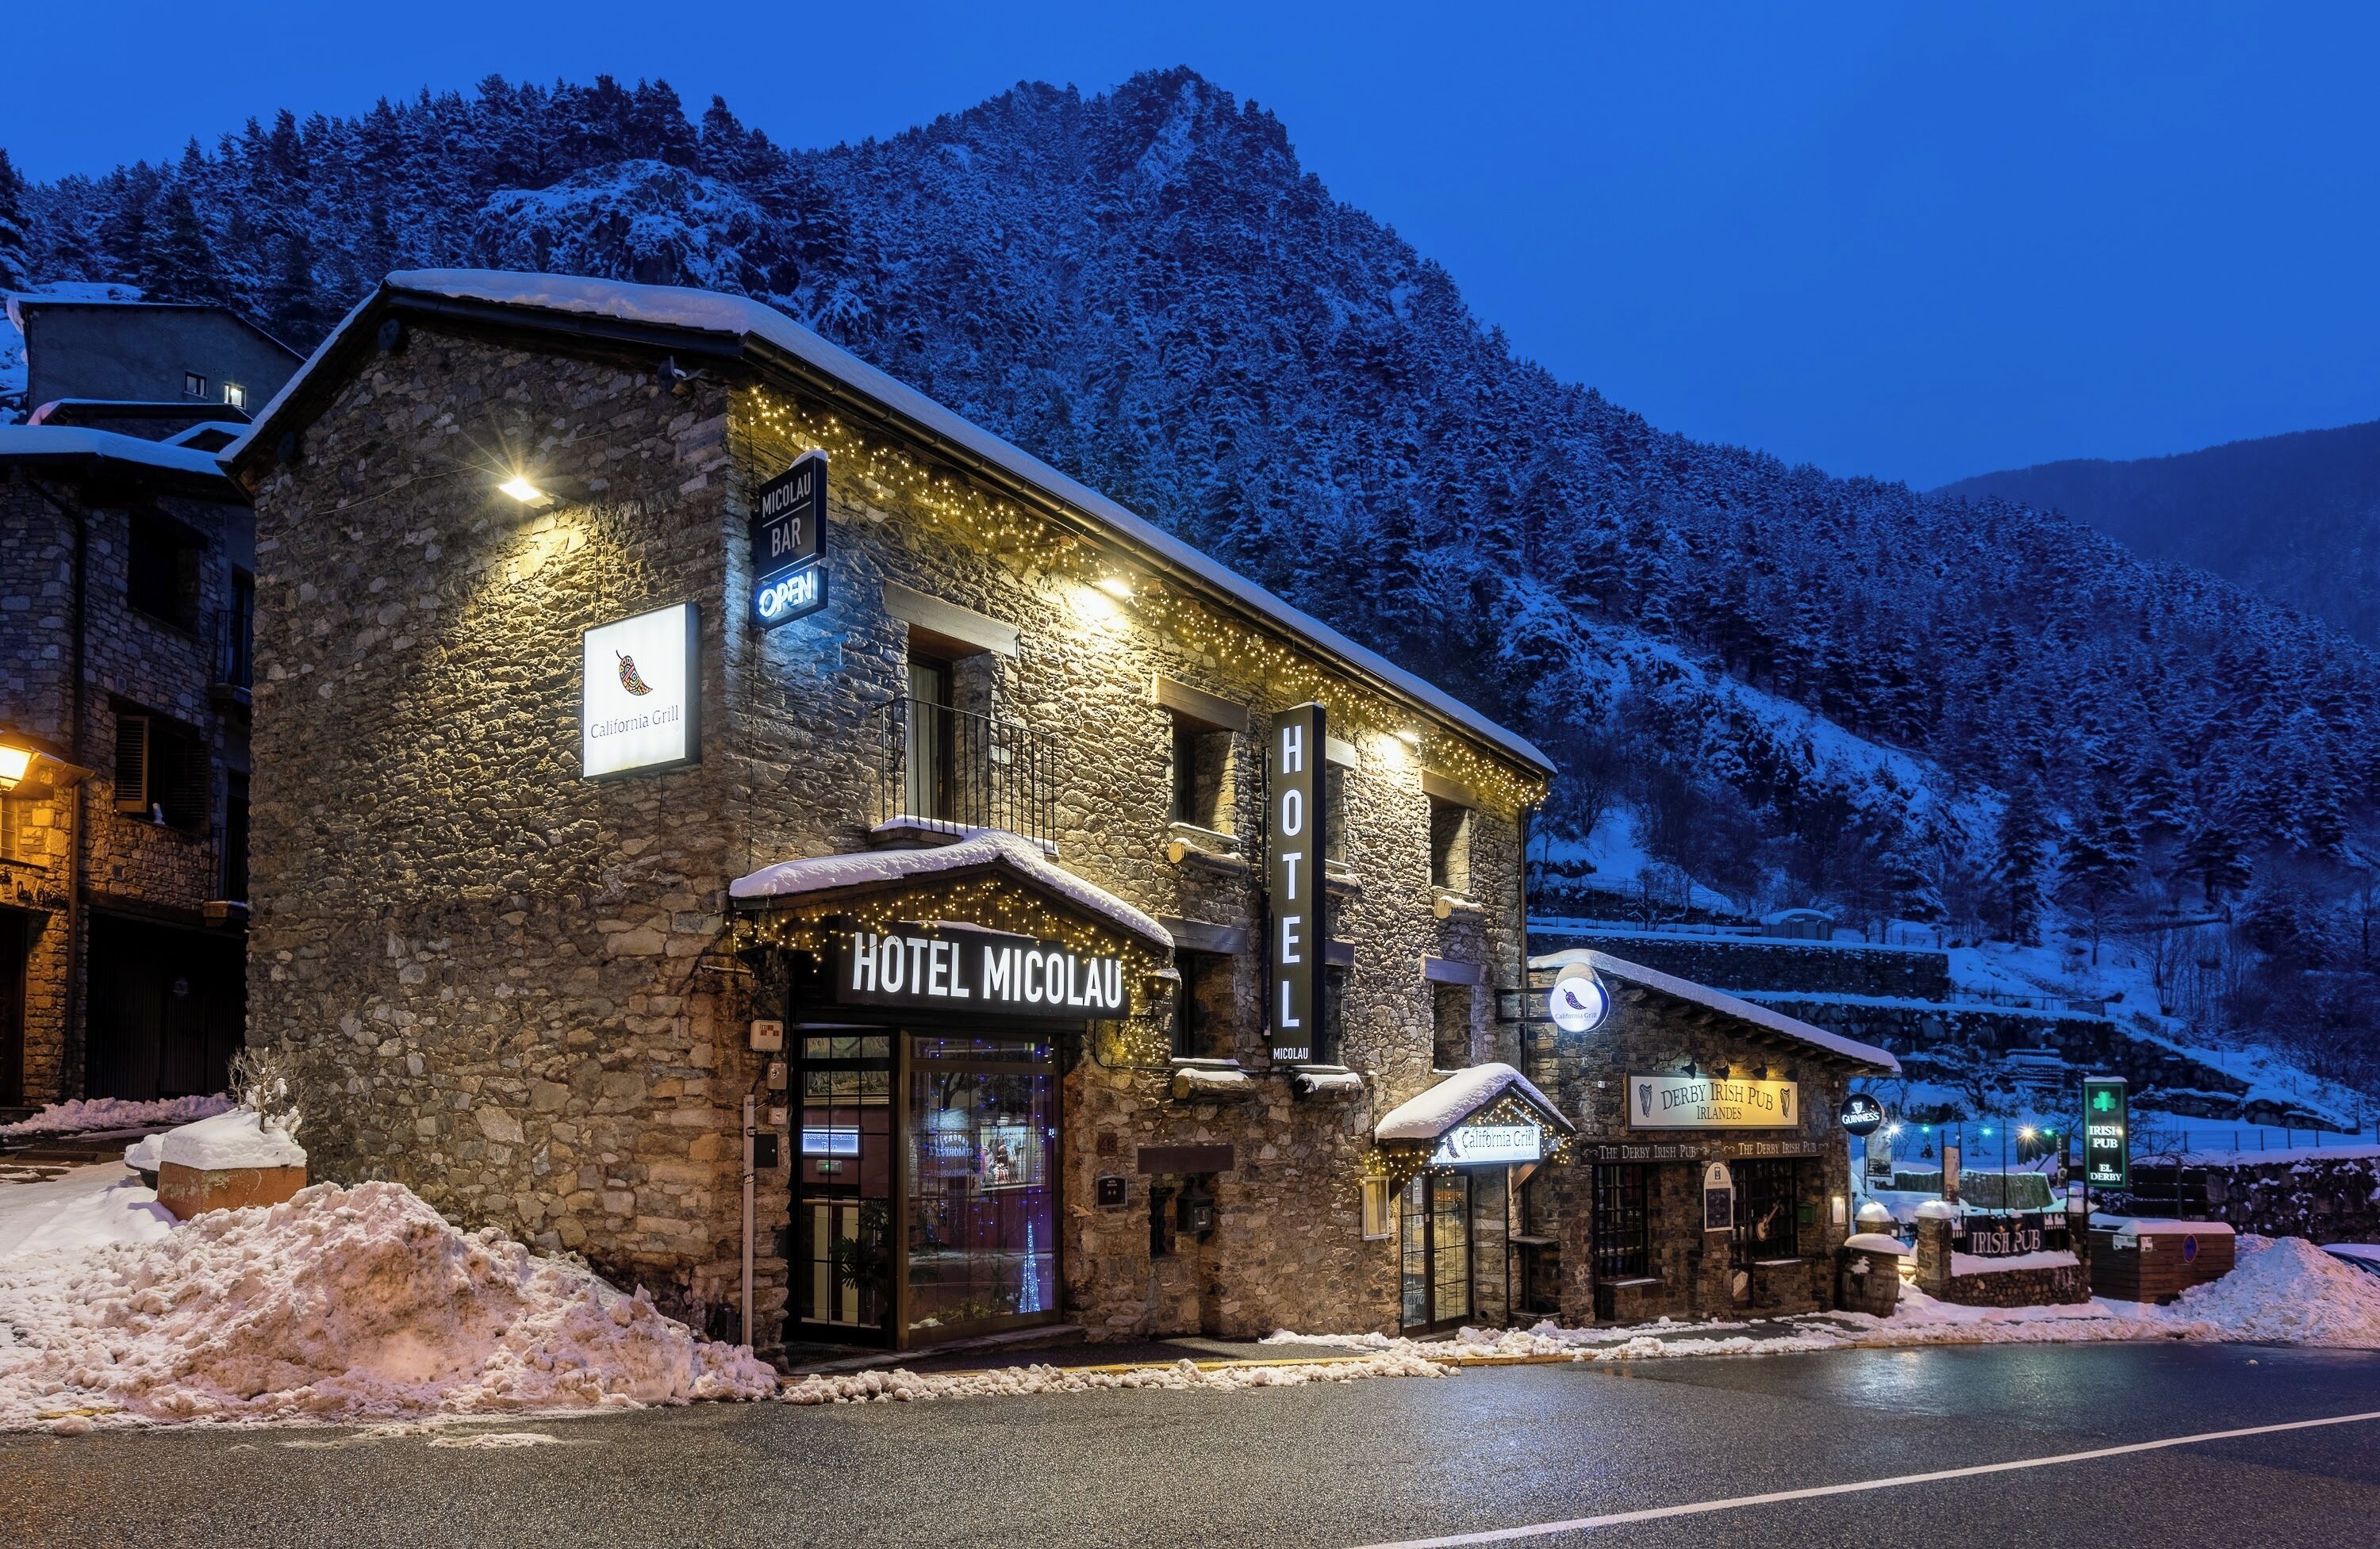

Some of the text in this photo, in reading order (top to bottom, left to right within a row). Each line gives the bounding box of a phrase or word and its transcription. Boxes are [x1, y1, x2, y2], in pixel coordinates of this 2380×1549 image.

[762, 472, 811, 518] MICOLAU
[772, 517, 801, 558] BAR
[759, 570, 812, 617] OPEN
[591, 705, 678, 738] California Grill
[1281, 725, 1303, 1028] HOTEL
[852, 932, 1123, 1008] HOTEL MICOLAU
[1273, 1047, 1308, 1060] MICOLAU
[1660, 1082, 1773, 1111] DERBY IRISH PUB
[1696, 1106, 1742, 1120] IRLANDES
[1841, 1112, 1879, 1125] GUINNESS
[1100, 1137, 1117, 1151] 48
[1462, 1129, 1534, 1148] California Grill
[2092, 1137, 2118, 1148] PUB
[1599, 1144, 1696, 1159] THE DERBY IRISH PUB
[1738, 1141, 1817, 1156] THE DERBY IRISH PUB
[2090, 1171, 2123, 1182] DERBY
[2099, 1164, 2113, 1173] EL
[1971, 1229, 2040, 1254] IRISH PUB
